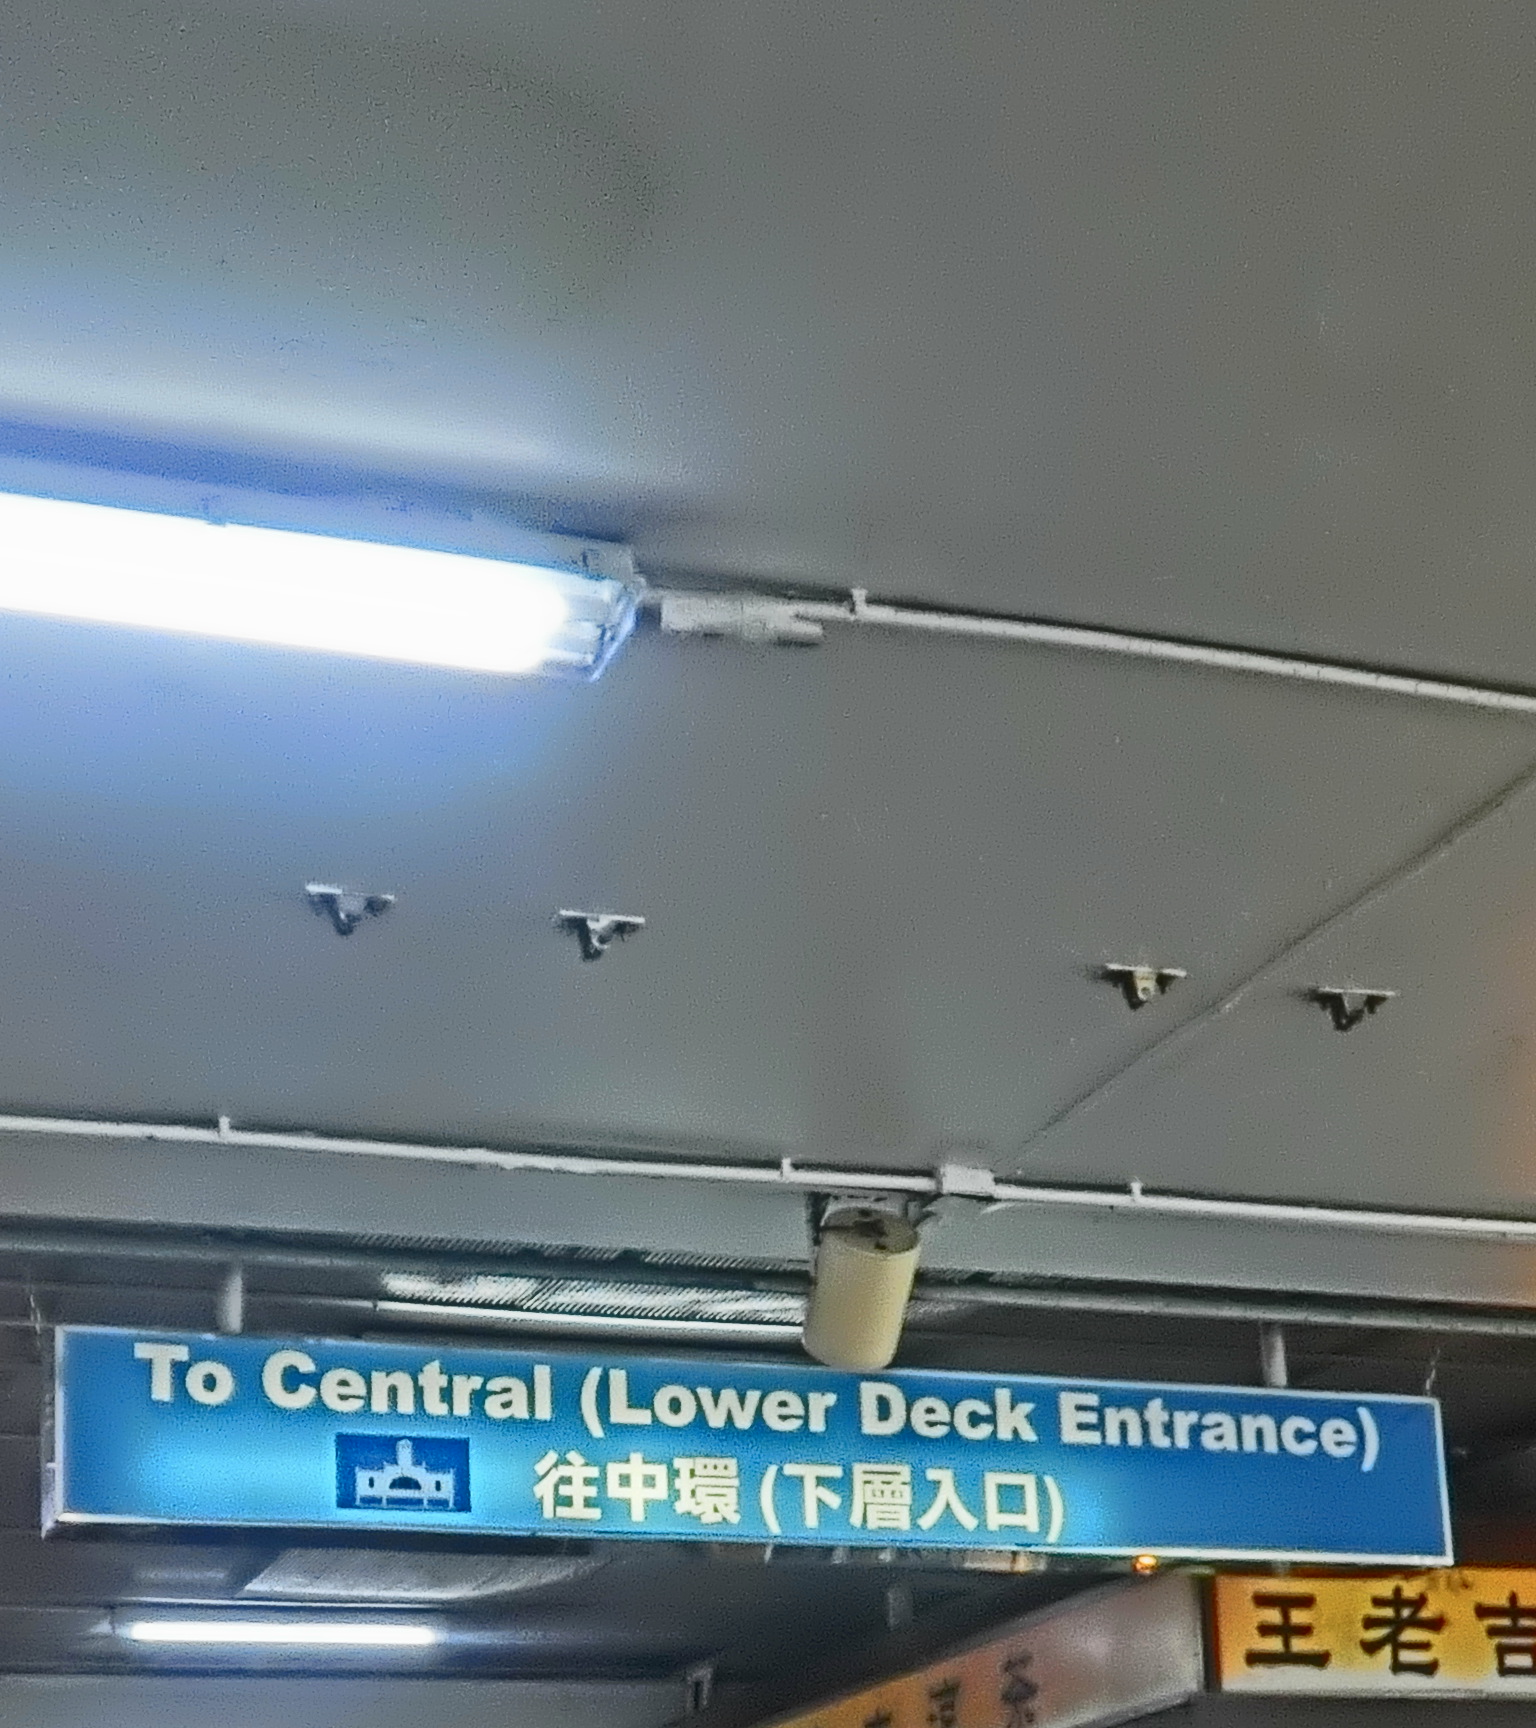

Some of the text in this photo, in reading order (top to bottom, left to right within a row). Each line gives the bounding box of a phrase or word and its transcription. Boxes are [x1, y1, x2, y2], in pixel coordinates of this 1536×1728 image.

[134, 1342, 1381, 1472] To Central (Lower Deck Entrance)
